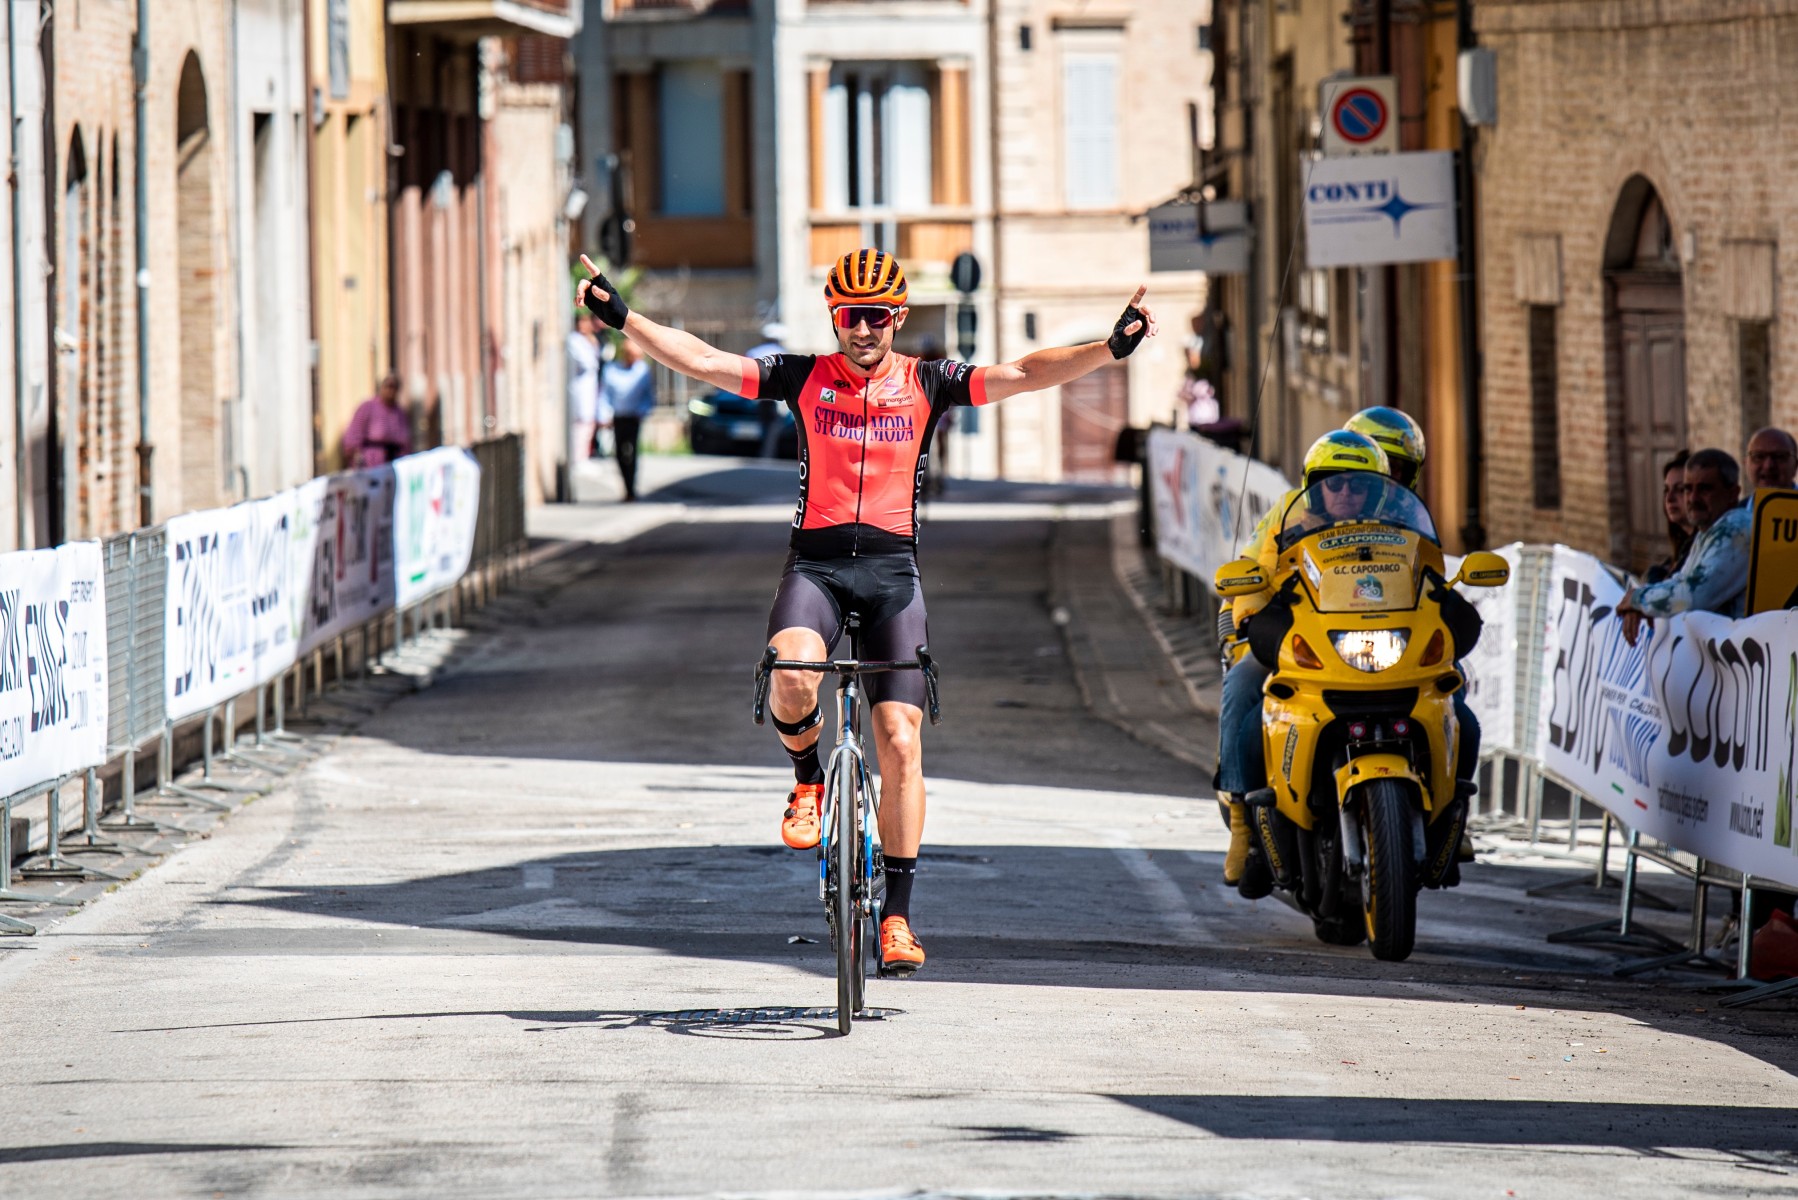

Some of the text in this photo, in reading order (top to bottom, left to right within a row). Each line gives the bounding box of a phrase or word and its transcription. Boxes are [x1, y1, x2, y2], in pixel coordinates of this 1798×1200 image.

[1308, 180, 1389, 204] CONTI
[814, 406, 914, 442] STUDIO MODA
[1341, 533, 1405, 547] CAPODARCO
[1333, 563, 1400, 575] G.C. CAPODARCO
